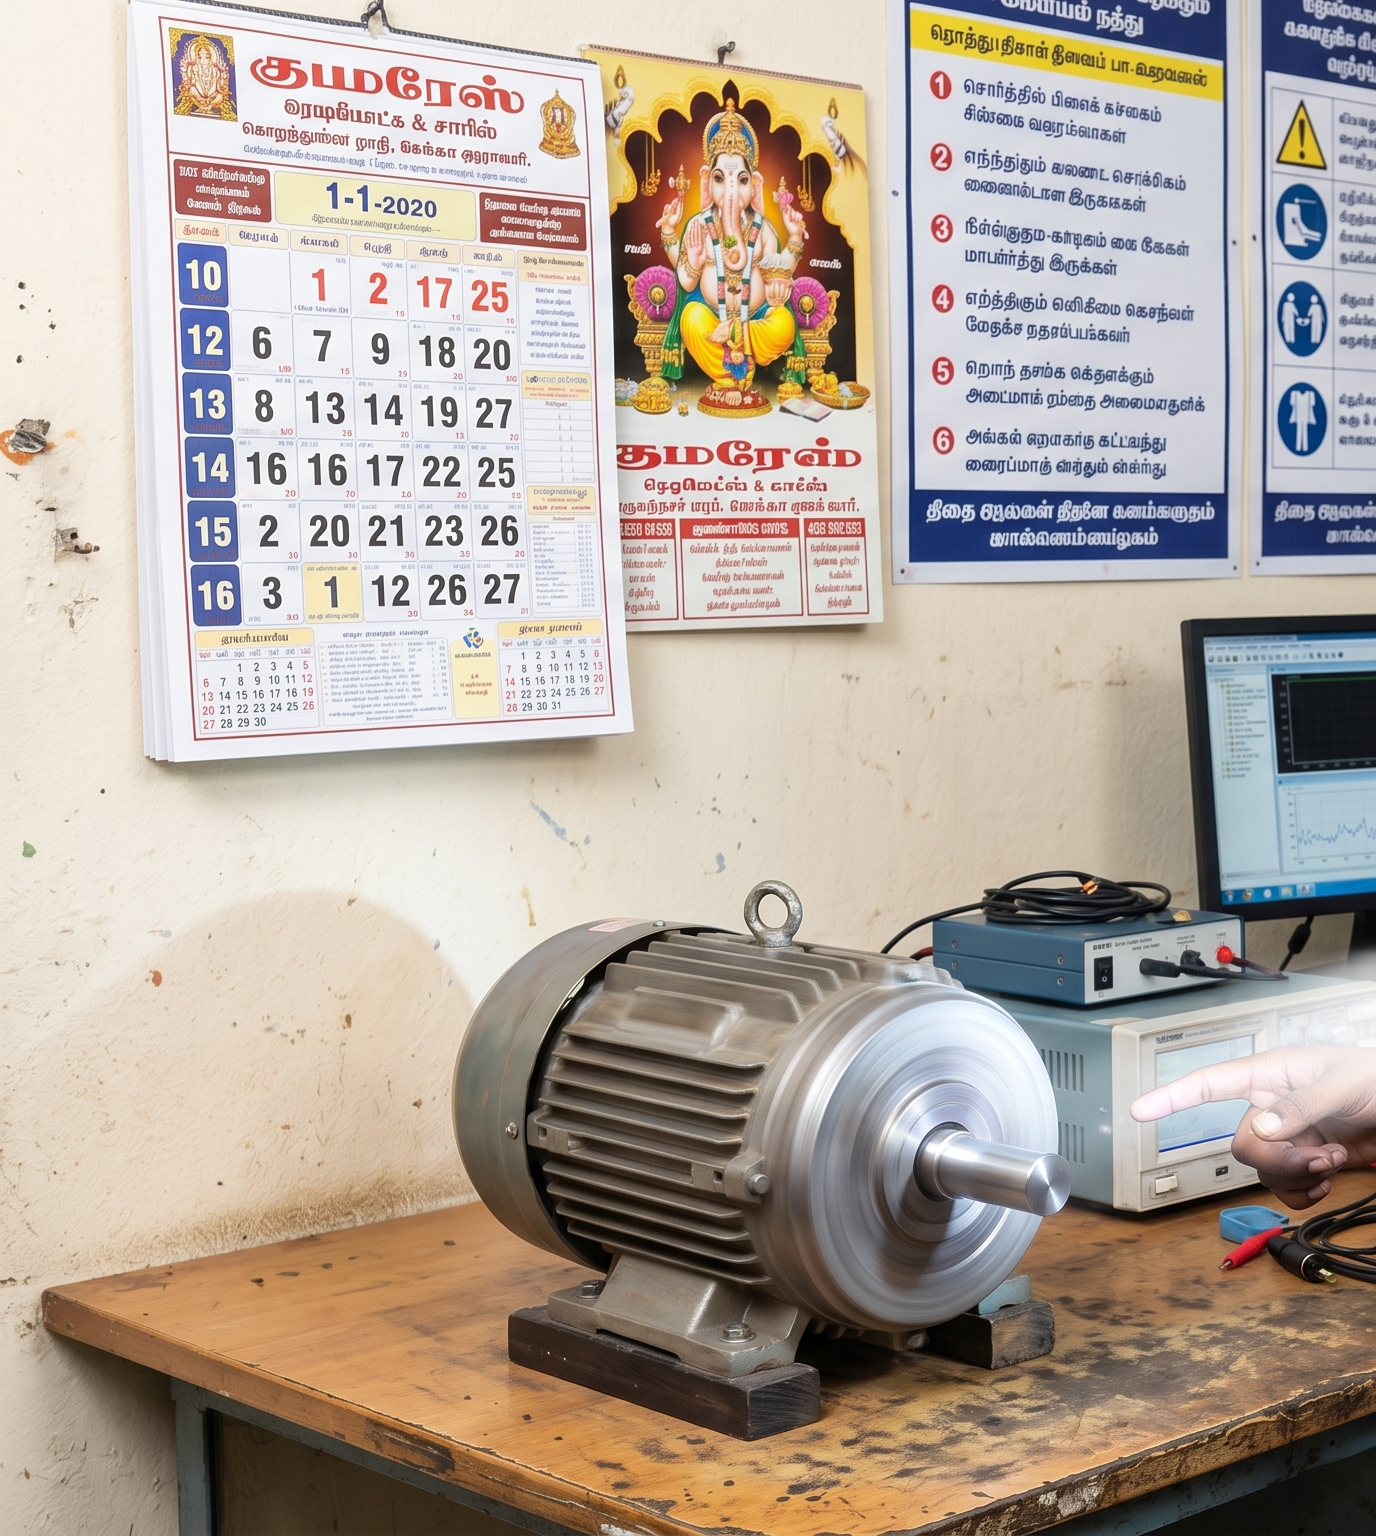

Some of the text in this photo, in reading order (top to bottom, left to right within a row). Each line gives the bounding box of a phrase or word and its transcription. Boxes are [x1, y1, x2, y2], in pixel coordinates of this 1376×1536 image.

[412, 113, 427, 132] &
[934, 147, 948, 169] 2
[326, 182, 437, 219] 1-1-2020
[935, 218, 949, 240] 3
[186, 259, 508, 313] 10 1 2 17 25
[935, 288, 950, 310] 4
[187, 324, 510, 370] 12 6 7 9 18 20
[936, 360, 950, 382] 5
[189, 388, 512, 429] 13 8 13 14 19 27
[936, 430, 950, 451] 6
[191, 452, 515, 488] 14 16 16 17 22 25
[754, 480, 764, 492] &
[194, 514, 518, 548] 15 2 20 21 23 26
[197, 574, 520, 612] 16 3 1 12 26 27
[521, 652, 525, 660] 1
[536, 651, 541, 659] 2
[566, 650, 570, 658] 4
[581, 650, 585, 658] 5
[238, 661, 308, 672] 1 2 3 4 5
[507, 662, 603, 673] 7 8 9 10 11 12 13
[203, 674, 312, 687] 6 7 8 9 10 11 12
[505, 678, 515, 686] 14
[520, 677, 530, 685] 15
[535, 677, 545, 685] 16
[550, 676, 559, 684] 17
[580, 675, 589, 683] 19
[594, 674, 604, 682] 20
[202, 687, 314, 701] 13 14 15 16 17 18 19
[506, 691, 516, 699] 21
[551, 689, 561, 697] 24
[566, 688, 576, 696] 25
[580, 687, 590, 695] 26
[594, 687, 604, 695] 27
[203, 701, 314, 715] 20 21 22 23 24 25 26
[522, 703, 532, 711] 29
[537, 702, 547, 710] 30
[203, 717, 266, 729] 27 28 29 30
